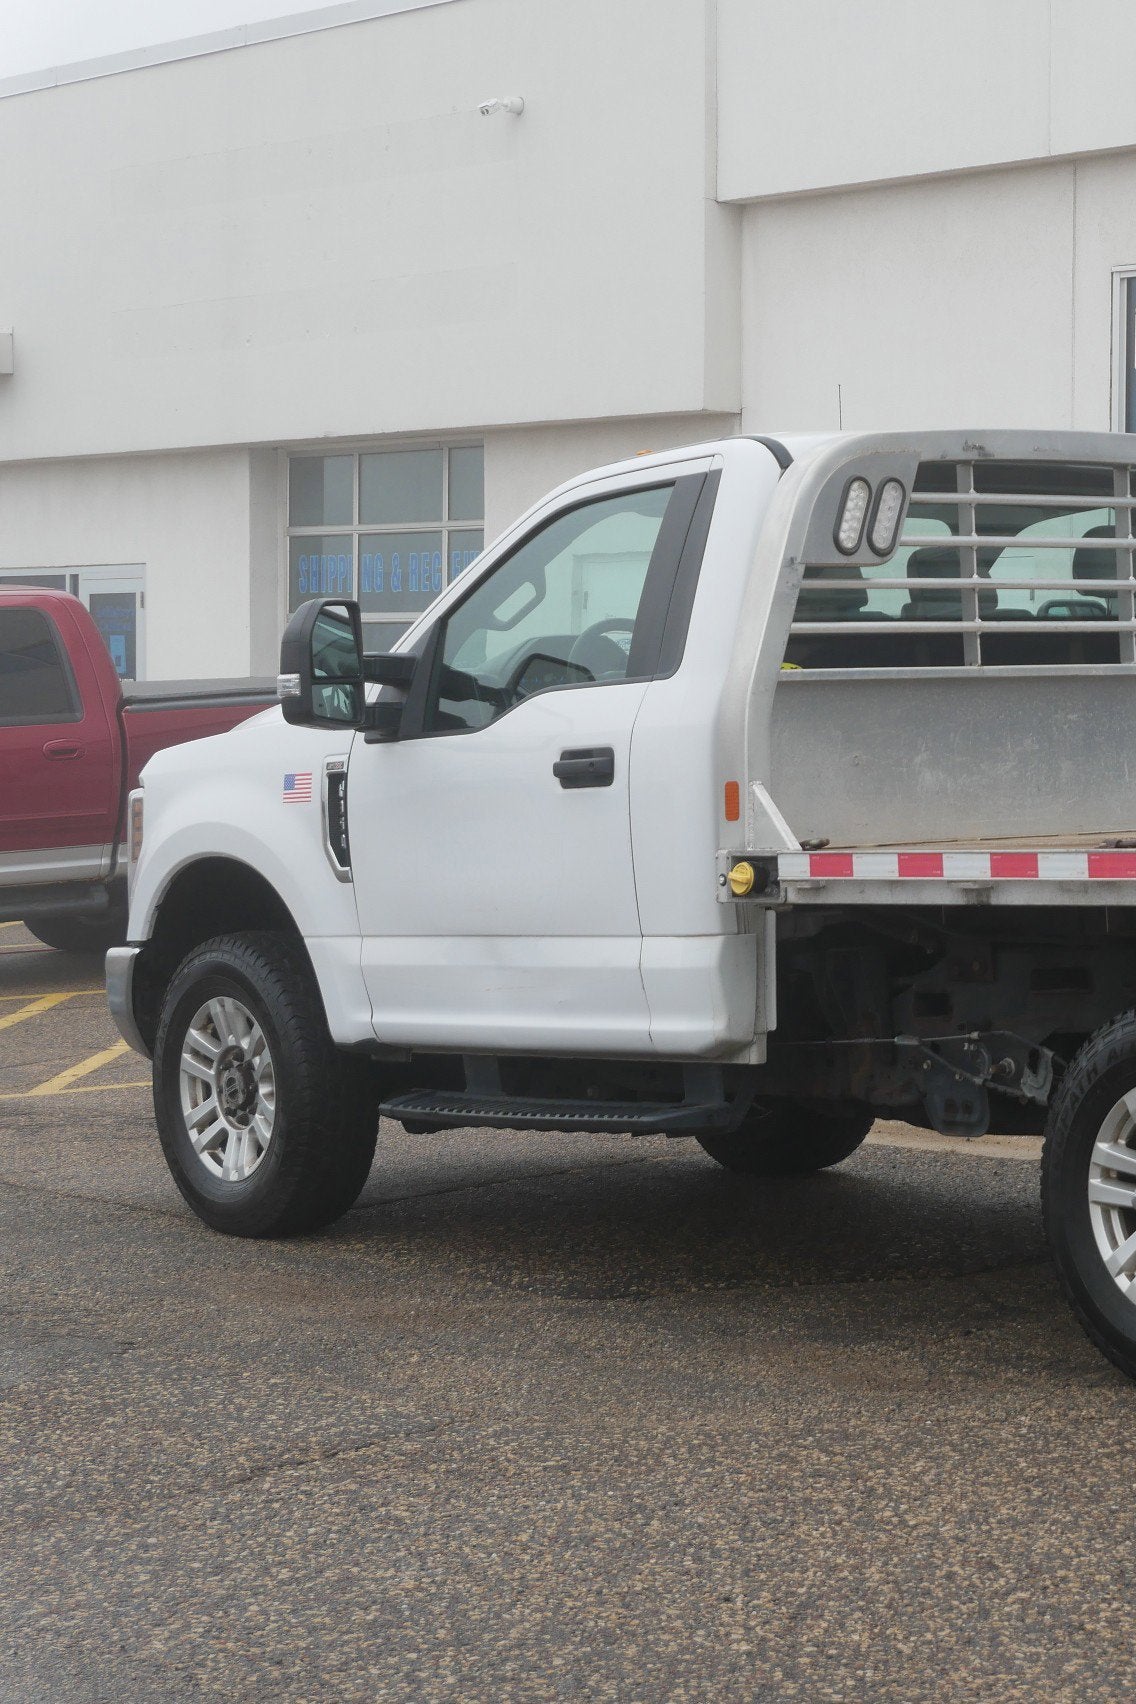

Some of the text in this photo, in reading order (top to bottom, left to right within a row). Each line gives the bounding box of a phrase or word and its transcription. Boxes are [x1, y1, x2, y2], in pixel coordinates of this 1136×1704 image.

[299, 550, 480, 593] SHIPPING & RECE
